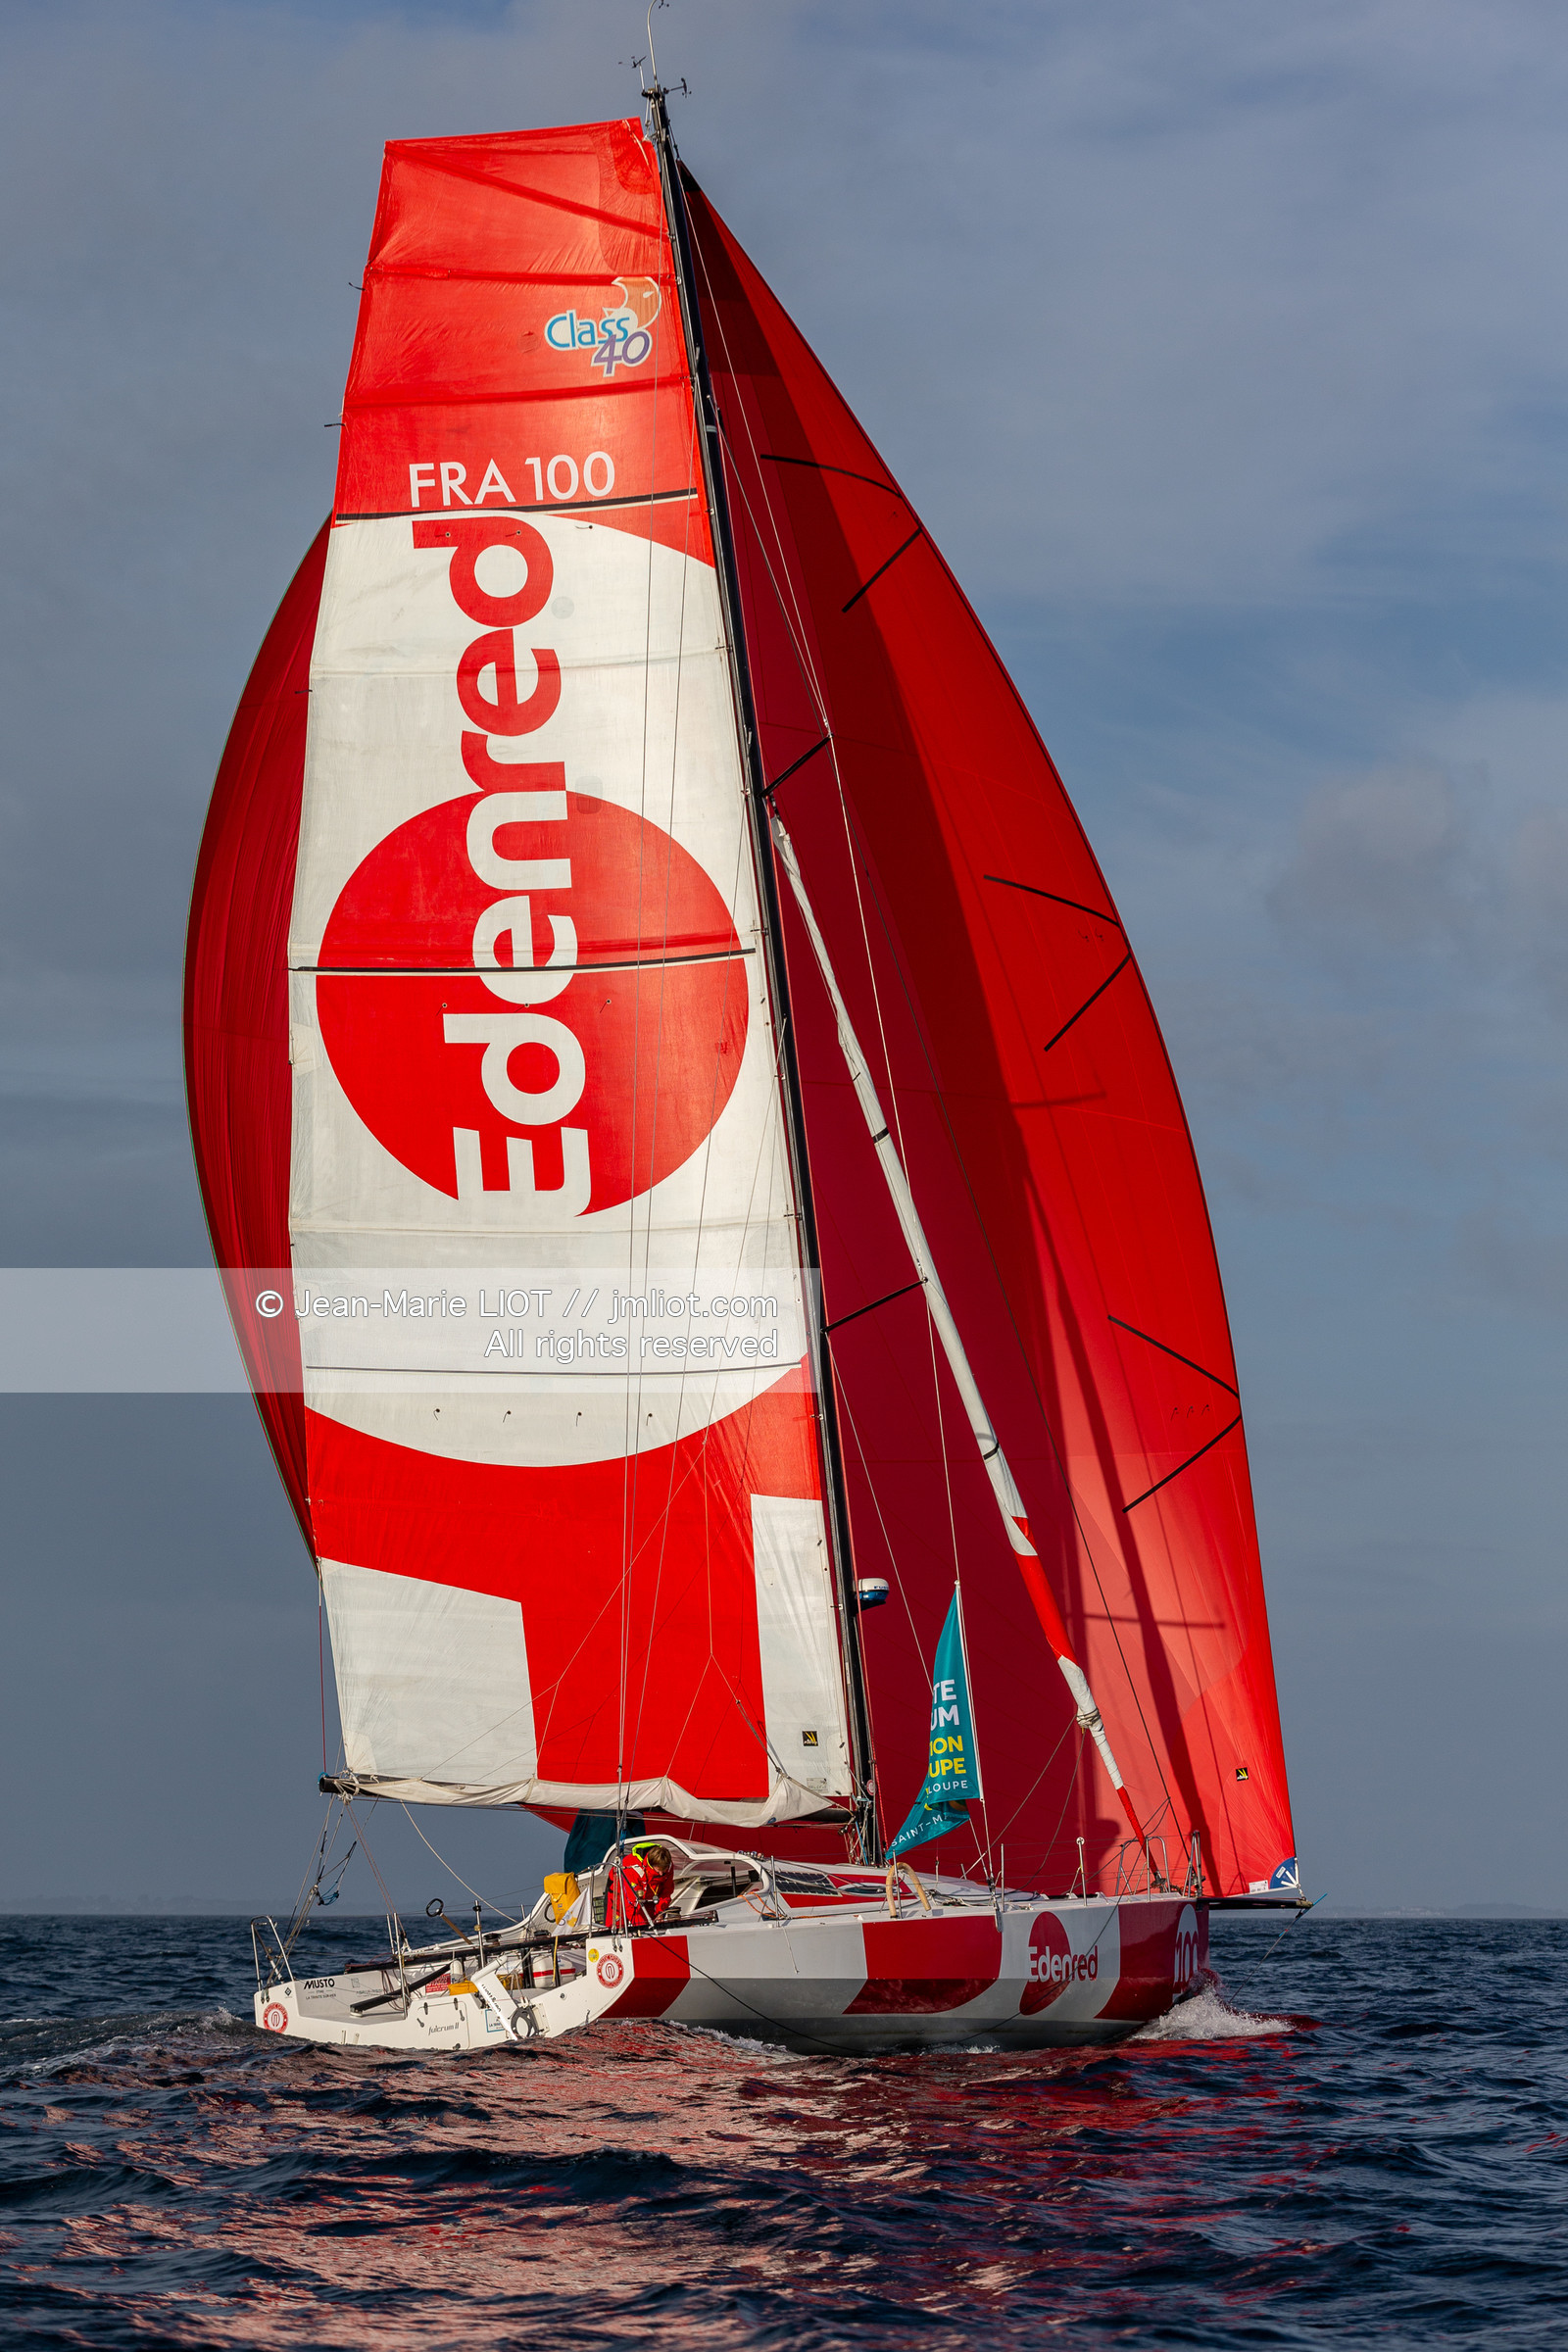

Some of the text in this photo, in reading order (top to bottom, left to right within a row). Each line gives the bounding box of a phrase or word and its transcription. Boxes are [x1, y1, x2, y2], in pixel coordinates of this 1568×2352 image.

[546, 311, 630, 349] Class
[593, 331, 651, 375] 40
[409, 451, 615, 508] FRA 100
[412, 515, 592, 1218] Edenred
[891, 1814, 947, 1847] SAINT-M
[1029, 1945, 1099, 1983] Edenred
[303, 1978, 335, 1990] MUSTO
[428, 2025, 455, 2035] fulcrum
